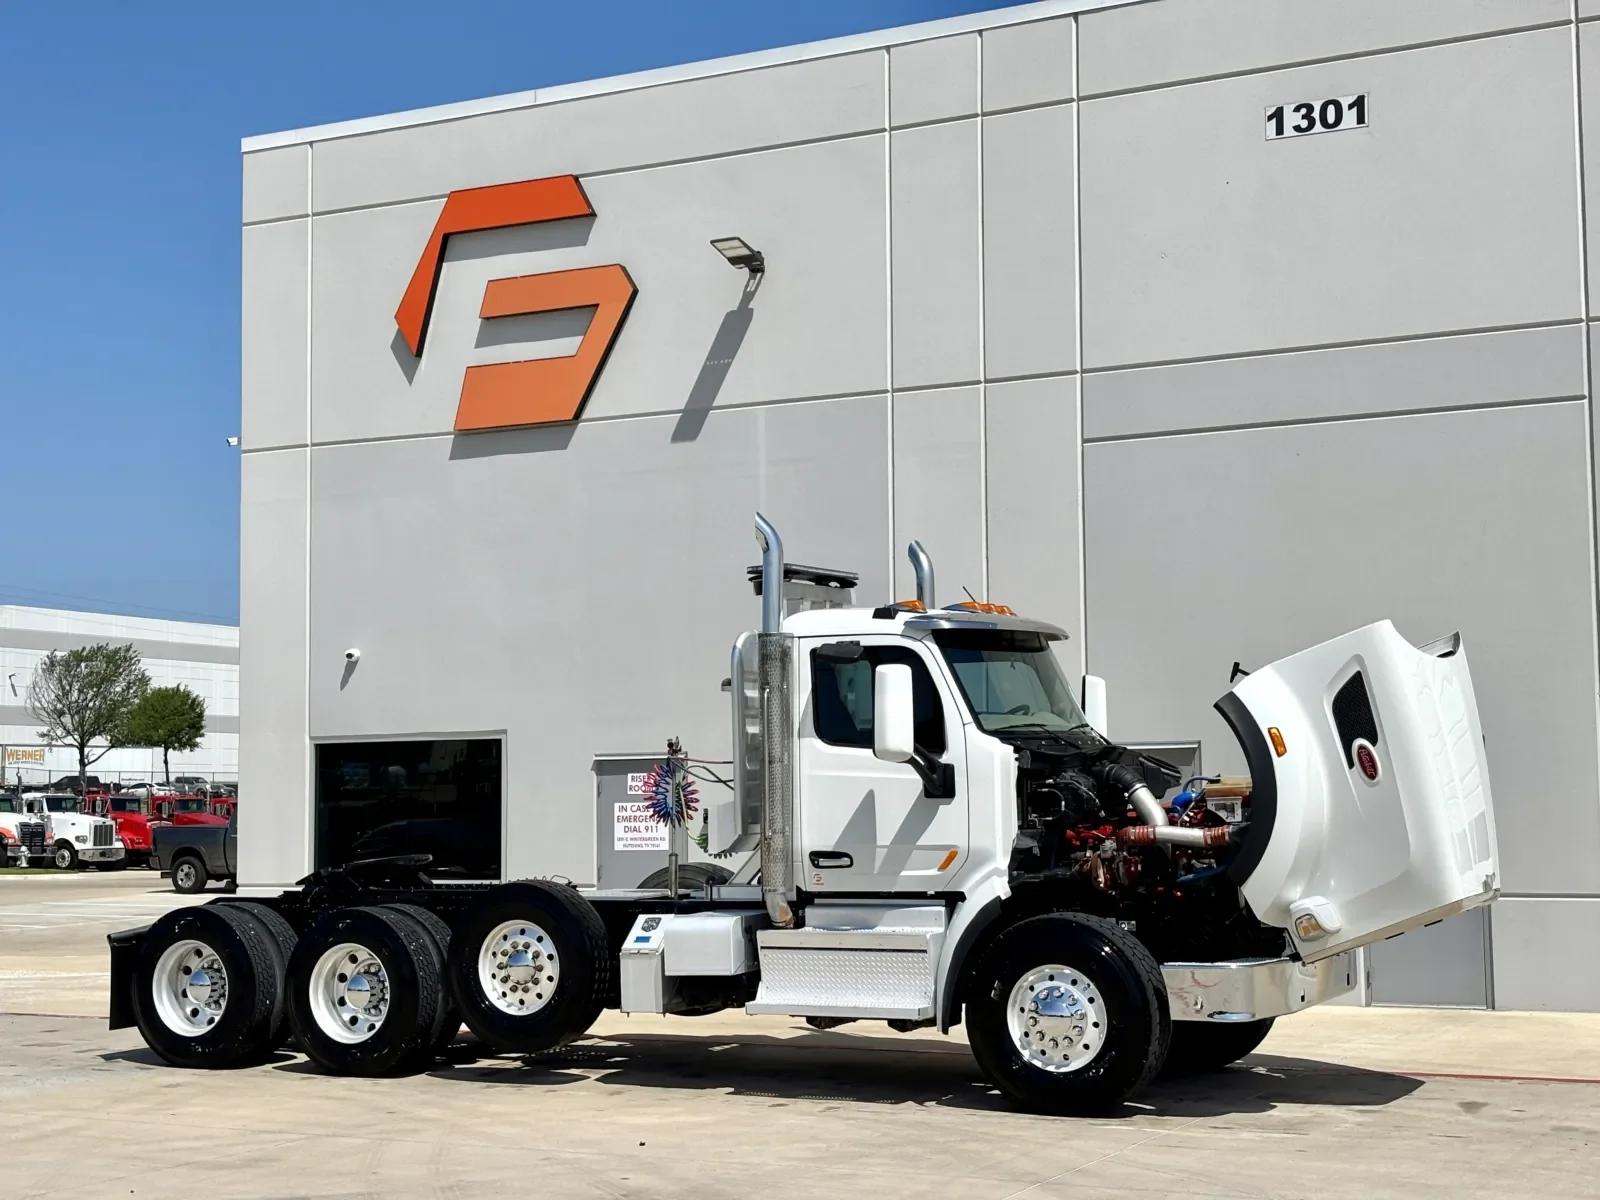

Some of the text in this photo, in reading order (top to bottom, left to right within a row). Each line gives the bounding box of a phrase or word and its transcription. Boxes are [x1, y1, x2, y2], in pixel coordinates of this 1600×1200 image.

[1267, 95, 1365, 136] 1301
[6, 749, 45, 761] WERNER
[631, 775, 652, 783] RISE
